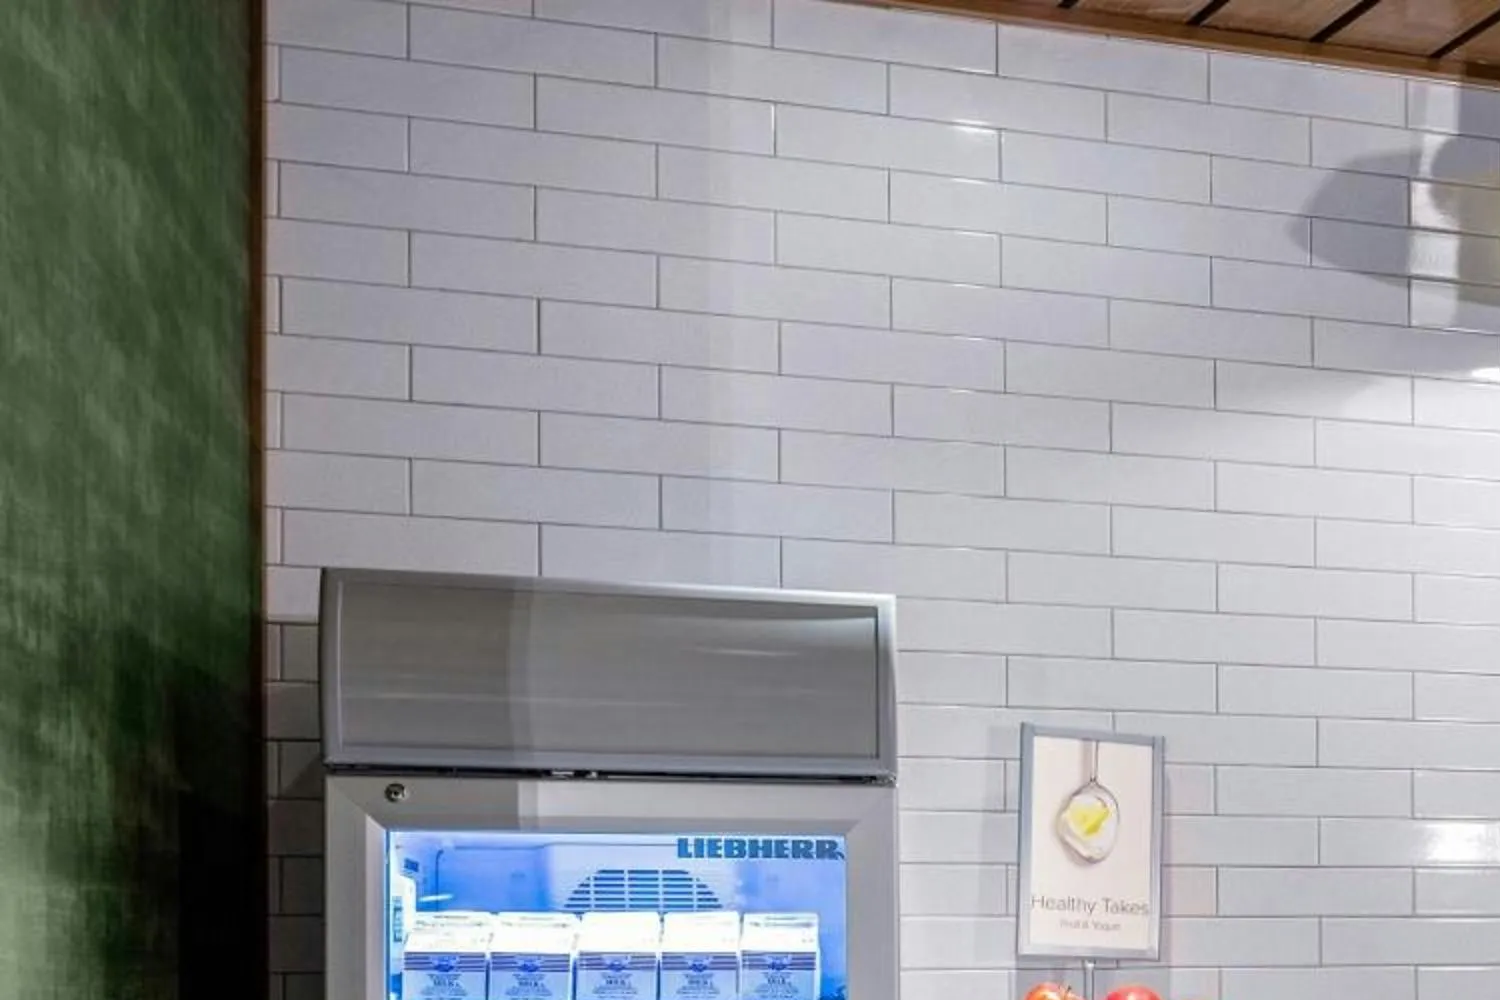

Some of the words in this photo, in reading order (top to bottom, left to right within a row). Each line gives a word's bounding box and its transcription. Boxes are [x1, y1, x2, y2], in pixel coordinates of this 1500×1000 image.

[677, 837, 845, 860] LIEBHERR
[1031, 895, 1097, 916] Healthy
[1101, 897, 1149, 915] Takes
